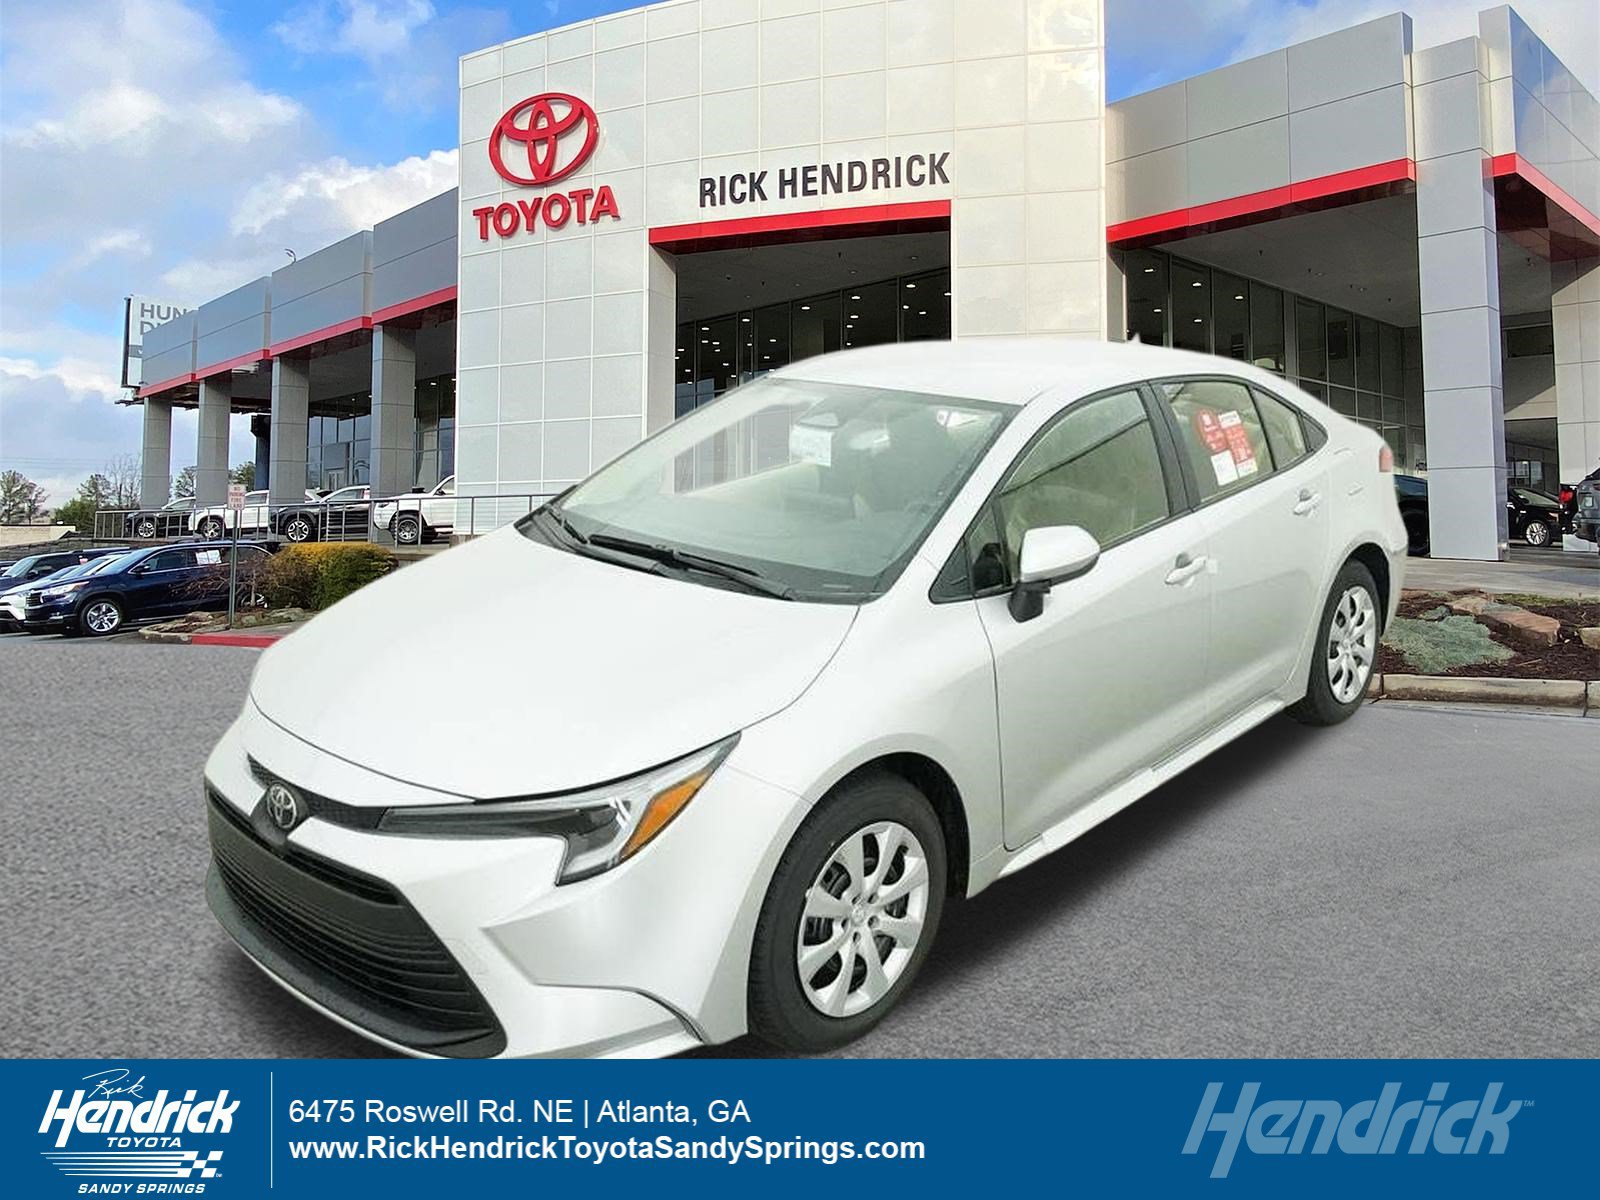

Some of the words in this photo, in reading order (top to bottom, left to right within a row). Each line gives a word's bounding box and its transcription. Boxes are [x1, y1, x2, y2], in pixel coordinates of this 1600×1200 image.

[699, 170, 768, 208] RICK
[778, 151, 951, 199] HENDRICK
[472, 185, 621, 241] TOYOTA
